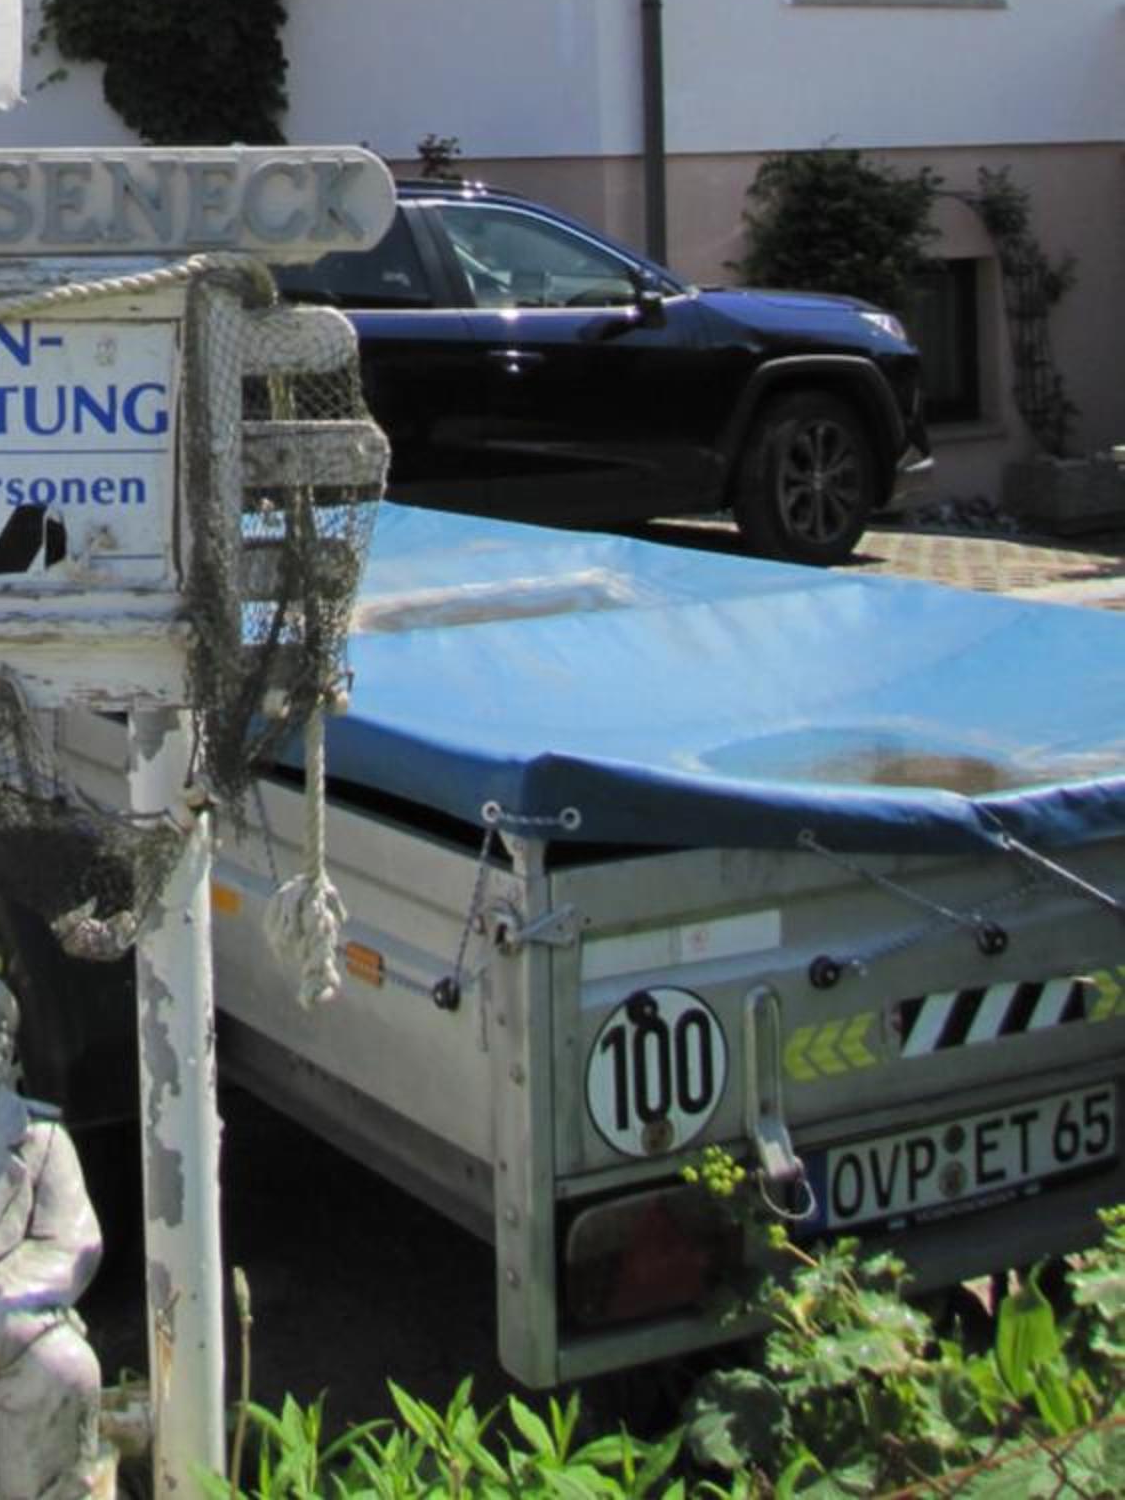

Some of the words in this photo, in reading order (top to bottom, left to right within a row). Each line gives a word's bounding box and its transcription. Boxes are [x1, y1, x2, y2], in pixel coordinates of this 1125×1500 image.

[600, 1008, 714, 1131] 100
[831, 1137, 937, 1220] OVP
[976, 1110, 1039, 1184] ET
[1051, 1091, 1111, 1163] 65
